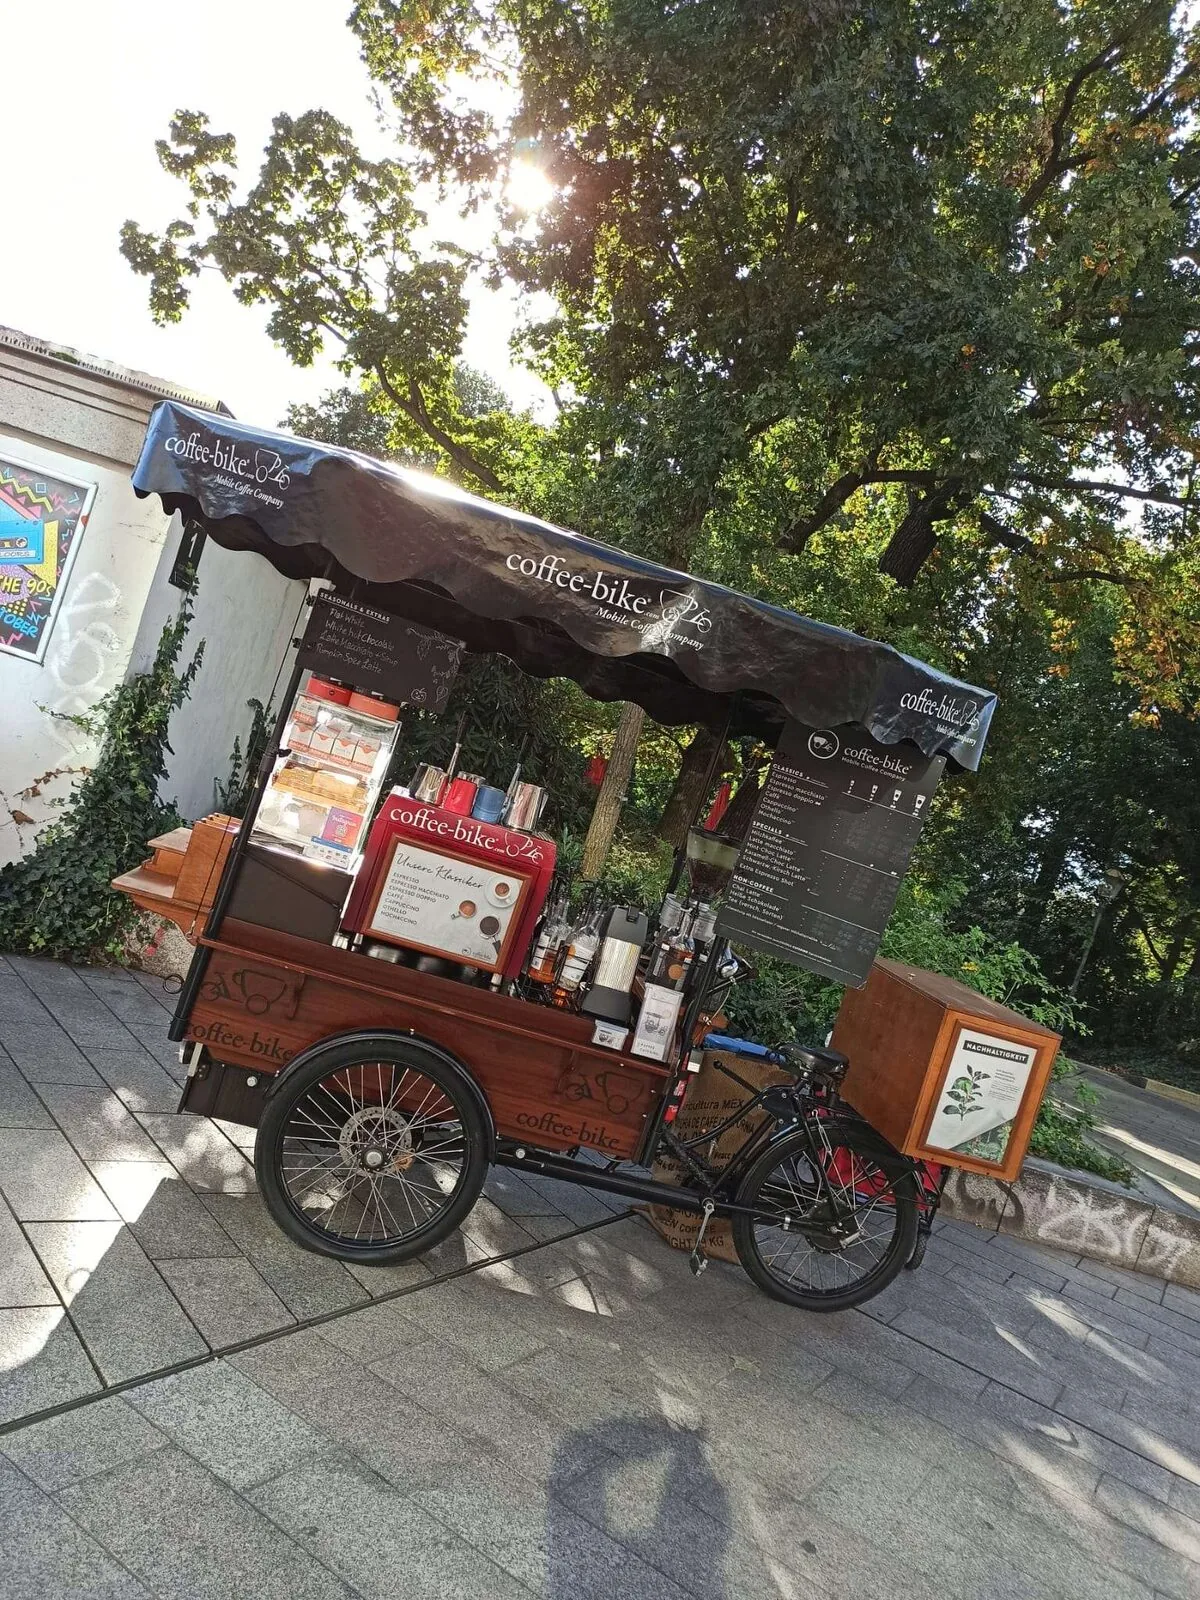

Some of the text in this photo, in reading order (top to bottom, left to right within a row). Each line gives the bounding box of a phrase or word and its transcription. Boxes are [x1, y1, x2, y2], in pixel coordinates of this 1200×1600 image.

[165, 432, 247, 476] coffee-bike
[214, 474, 284, 509] Mobile Coffee Company
[506, 553, 648, 614] coffee-bike
[320, 592, 358, 611] SEASONALS
[366, 610, 390, 622] EXTRAS
[595, 607, 628, 625] Mobile
[900, 688, 959, 722] coffee-bike
[773, 763, 803, 777] CLASSICS
[842, 757, 906, 782] Mobile Coffee Company
[844, 747, 910, 775] coffee-bike
[771, 771, 797, 784] Espresso
[767, 784, 814, 804] Espresso doppio
[769, 779, 794, 790] Espresso
[795, 787, 825, 800] macchiato
[390, 808, 497, 849] coffee-bike
[752, 829, 783, 844] Milchkaffee
[753, 821, 782, 834] SPECIALS
[749, 836, 794, 855] Latte macchiato
[396, 853, 433, 874] Unsere
[777, 853, 791, 862] Latte
[786, 862, 800, 872] Latte
[393, 872, 420, 884] ESPRESSO
[740, 863, 794, 887] Extra Espresso Shot
[791, 872, 806, 881] Latte
[389, 885, 437, 903] ESPRESSO DOPPIO
[391, 879, 450, 900] ESPRESSO MACCHIATO
[732, 883, 760, 897] Chai Latte
[383, 904, 407, 915] OTHELLO
[385, 898, 420, 912] CAPPUCCINO
[748, 897, 780, 911] Schokolade
[381, 911, 418, 926] MOCHACCINO
[966, 1042, 1027, 1062] NACHHALTIGKEIT
[517, 1112, 619, 1151] coffee-bike
